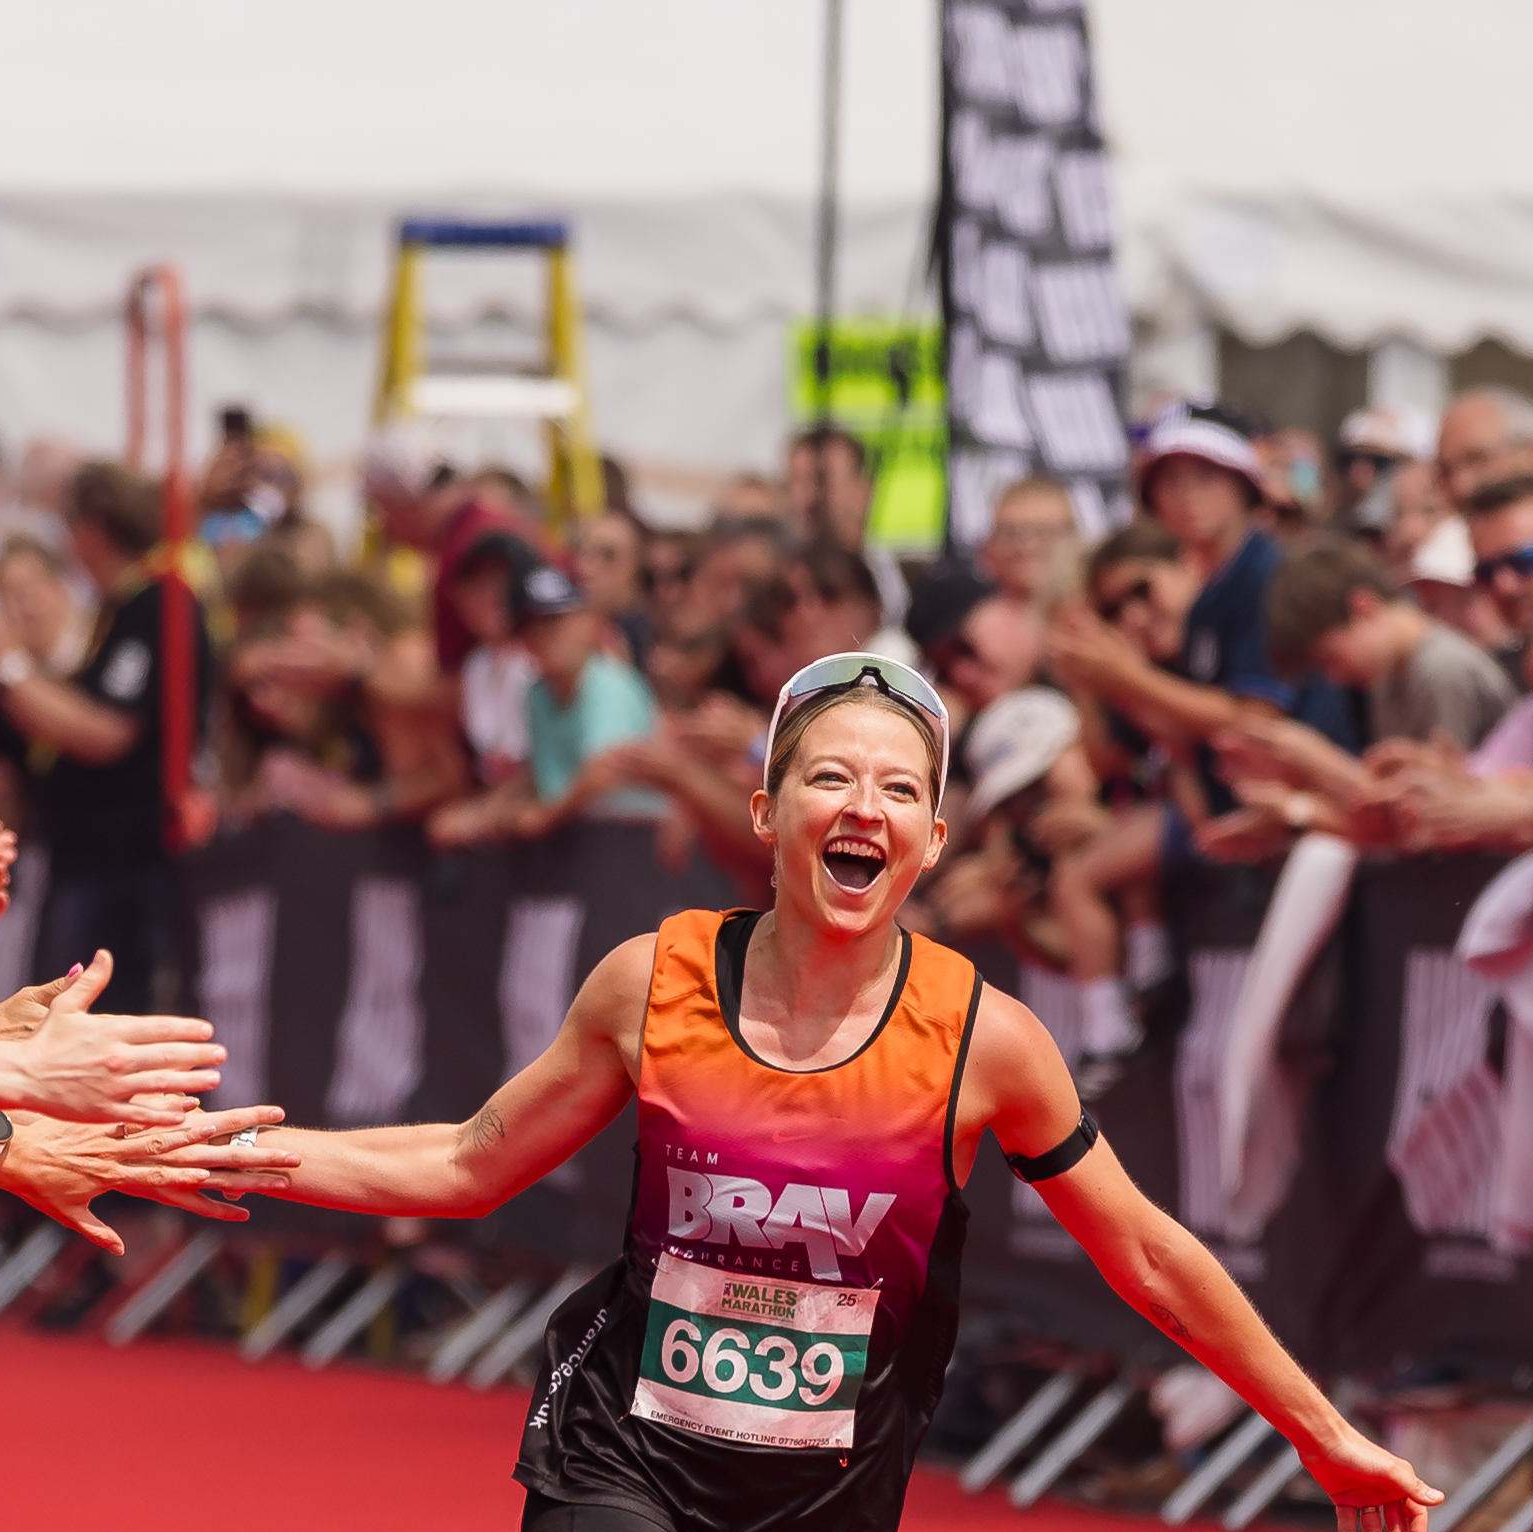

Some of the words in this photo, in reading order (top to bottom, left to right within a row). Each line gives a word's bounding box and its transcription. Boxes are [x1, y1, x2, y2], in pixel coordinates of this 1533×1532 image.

[665, 1144, 719, 1165] TEAM
[666, 1166, 897, 1281] BRAV
[661, 1243, 799, 1273] NDURANCE
[721, 1298, 796, 1319] MARATHON
[731, 1283, 798, 1307] WALES
[836, 1292, 858, 1307] 25
[661, 1318, 845, 1406] 6639
[650, 1410, 704, 1432] EMERGENCY
[704, 1425, 735, 1438] EVENT
[736, 1429, 777, 1444] HOTLINE
